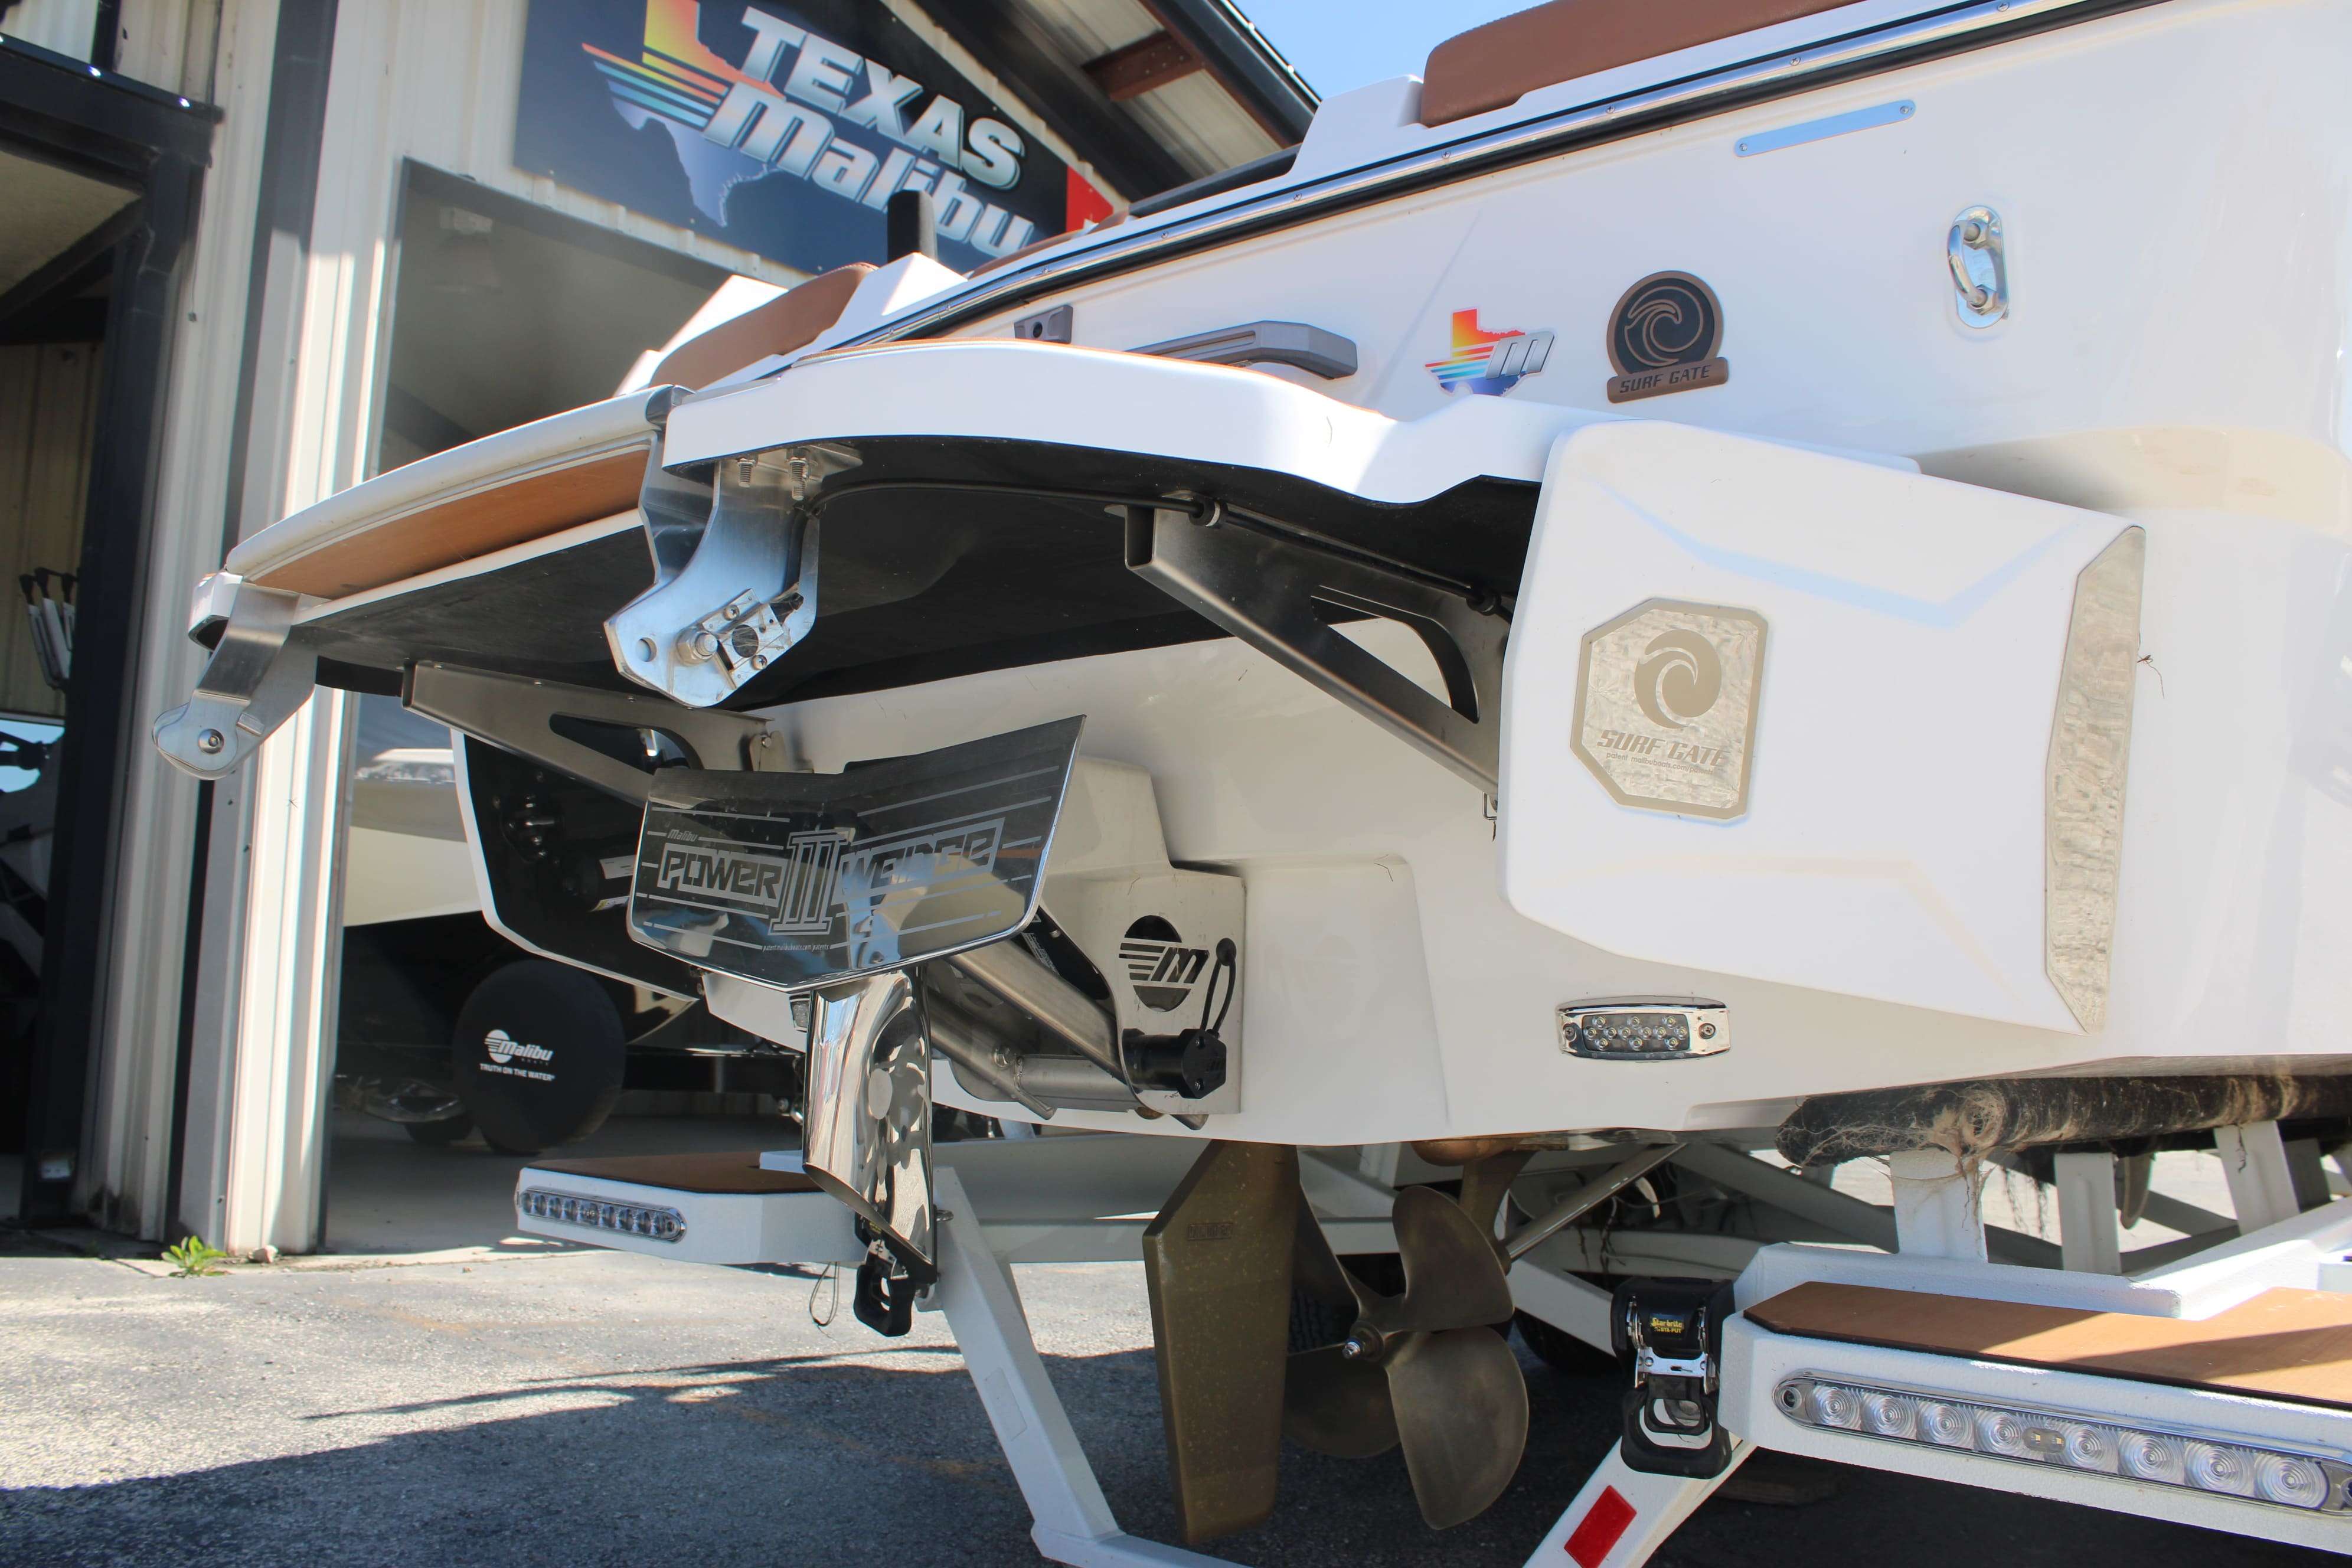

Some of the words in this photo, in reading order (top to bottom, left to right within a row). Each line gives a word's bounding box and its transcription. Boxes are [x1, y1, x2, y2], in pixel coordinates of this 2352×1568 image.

[741, 6, 1025, 190] TEXAS
[1619, 374, 1664, 394] SURF
[1669, 364, 1711, 384] GATE
[1596, 729, 1665, 755] SURF
[1667, 740, 1731, 767] GATE
[497, 1040, 554, 1061] Malibu
[479, 1063, 502, 1073] TRUTH
[514, 1068, 527, 1077] THE
